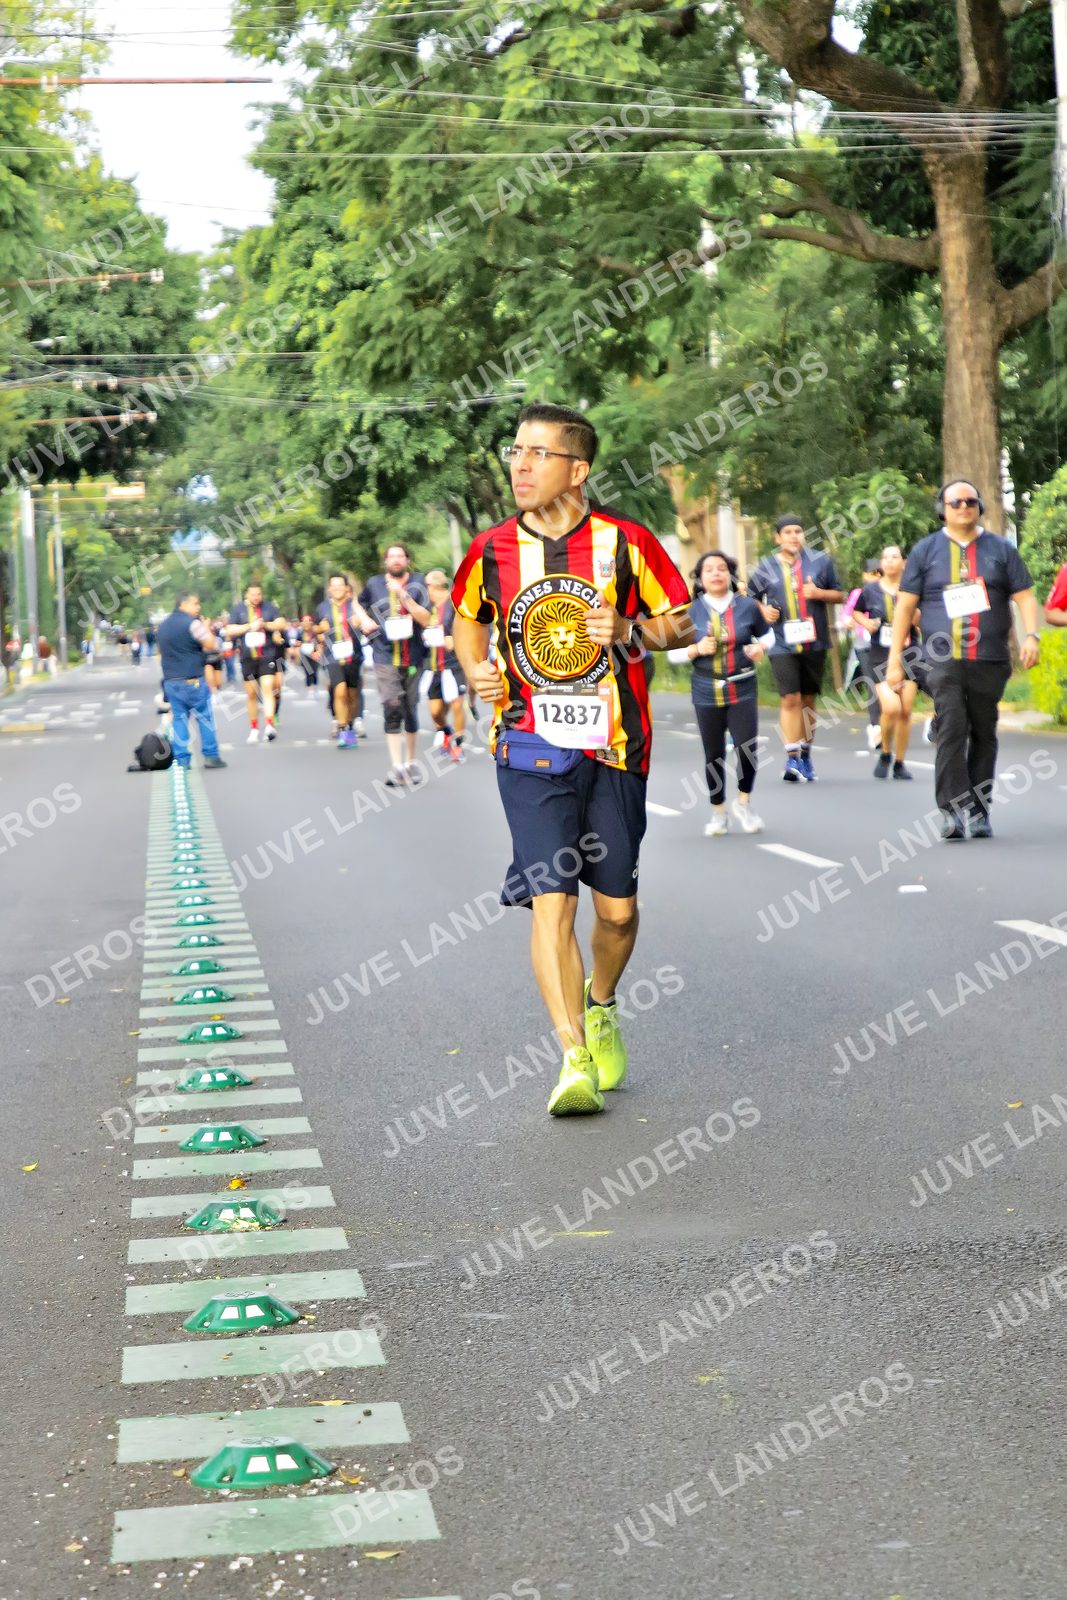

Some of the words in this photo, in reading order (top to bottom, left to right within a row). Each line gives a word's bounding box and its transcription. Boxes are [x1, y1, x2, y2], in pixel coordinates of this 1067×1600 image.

[511, 580, 553, 634] LEONES
[559, 579, 602, 609] NEGR
[515, 641, 554, 686] UNIVERSIDA
[539, 702, 602, 725] 12837
